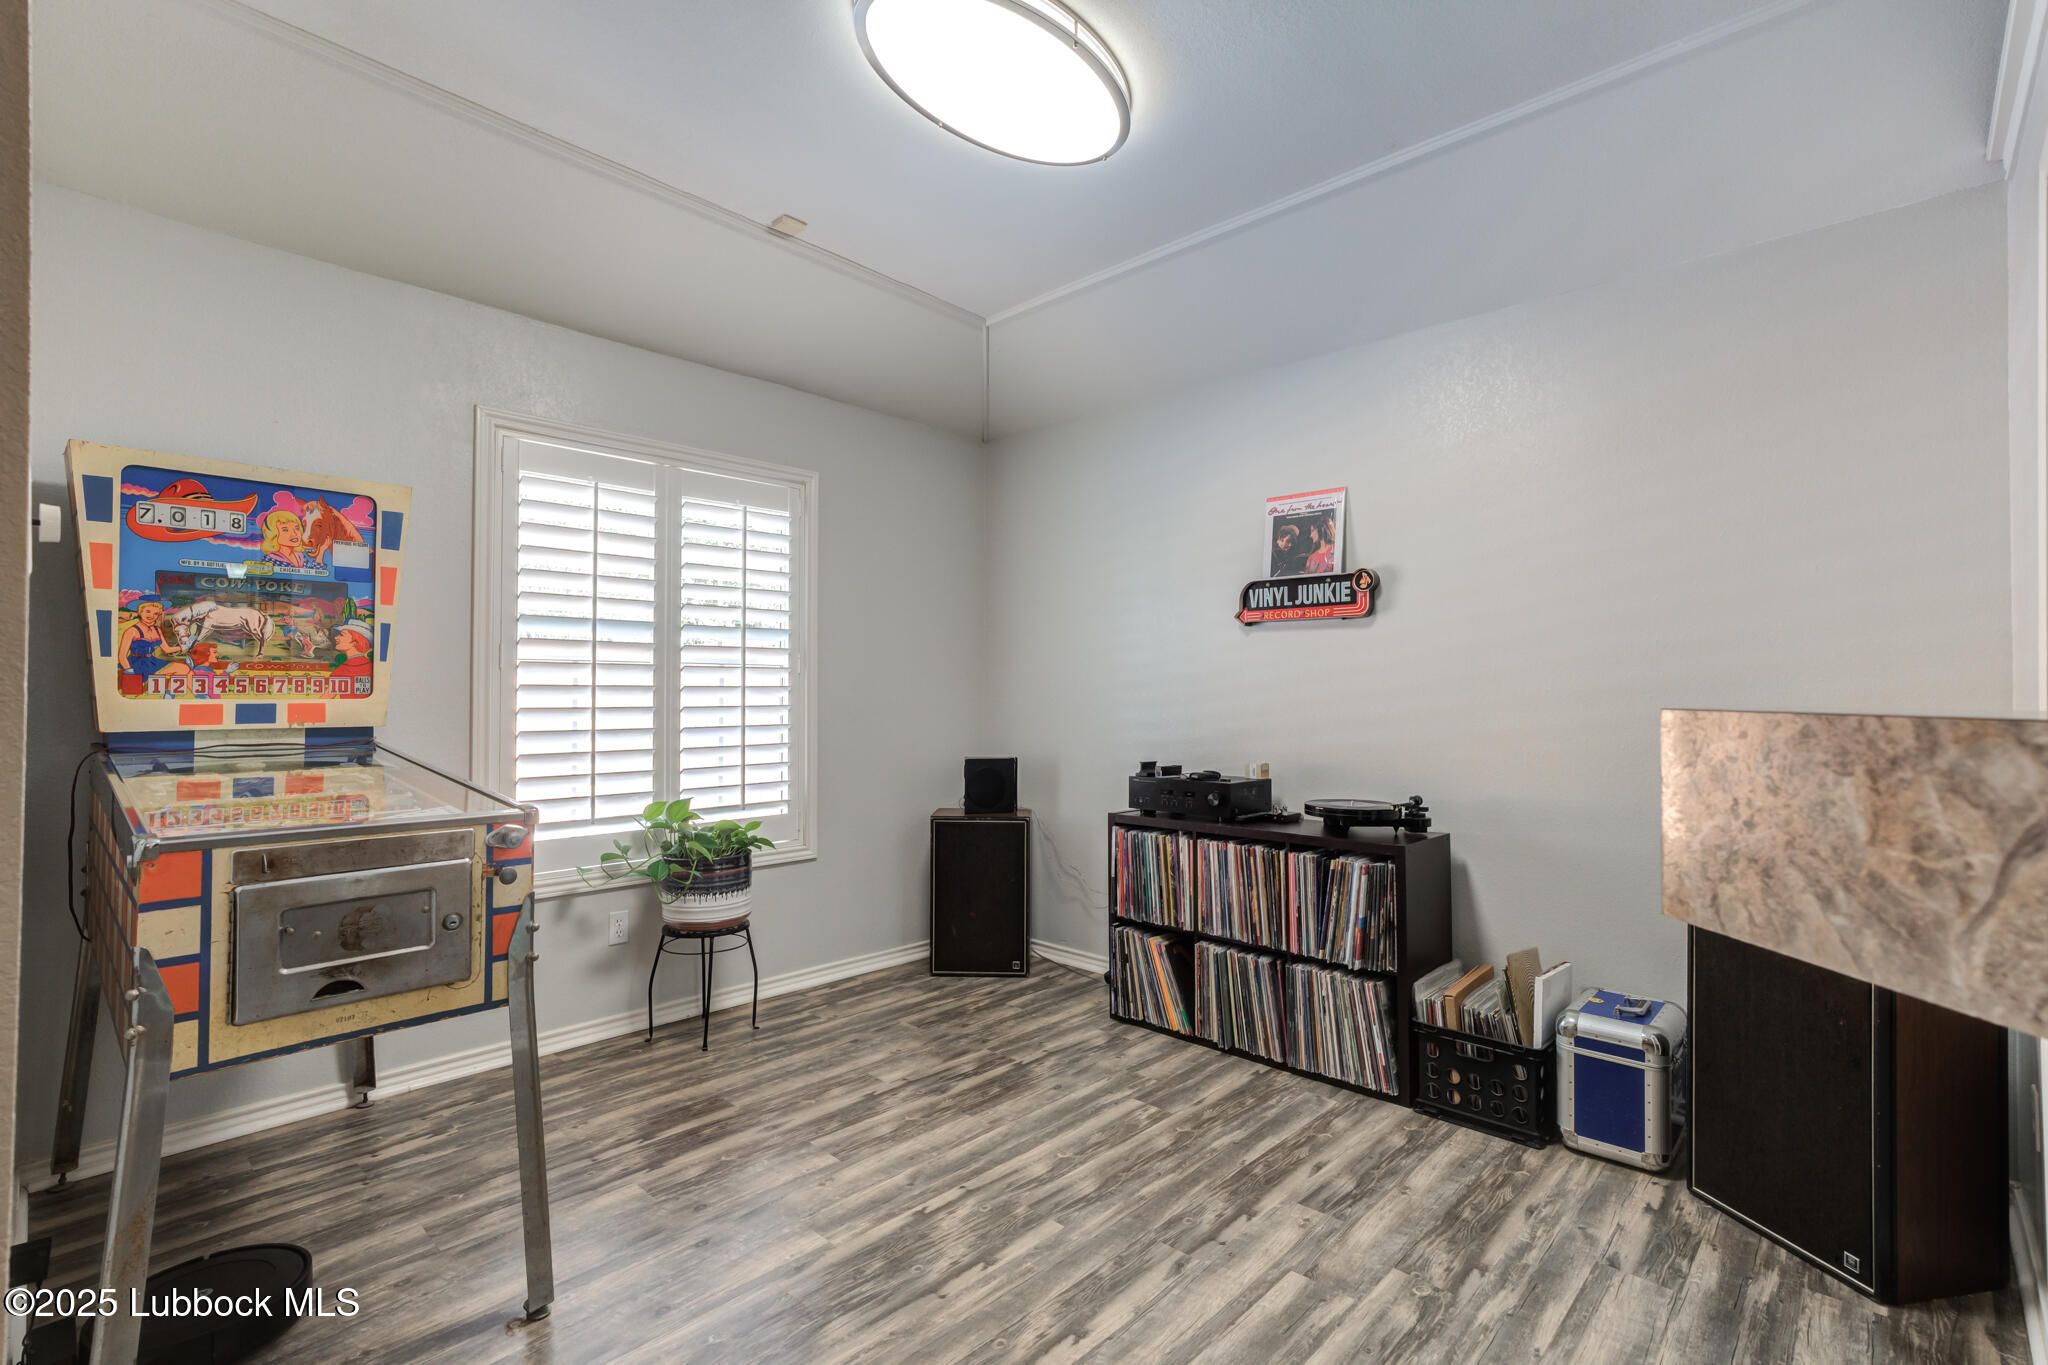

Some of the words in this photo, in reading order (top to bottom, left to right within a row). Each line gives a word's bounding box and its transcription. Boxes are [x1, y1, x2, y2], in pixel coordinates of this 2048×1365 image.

[1248, 586, 1292, 608] VINYL
[1295, 581, 1351, 605] JUNKIE
[1263, 610, 1301, 620] RECORD
[1304, 608, 1331, 618] SHOP
[152, 679, 161, 693] 1
[173, 679, 185, 693] 2
[195, 679, 206, 693] 3
[215, 679, 228, 693] 4
[236, 679, 247, 693] 5
[255, 679, 267, 693] 6
[275, 679, 286, 693] 7
[294, 679, 305, 693] 8
[312, 679, 323, 693] 9
[330, 679, 349, 693] 10
